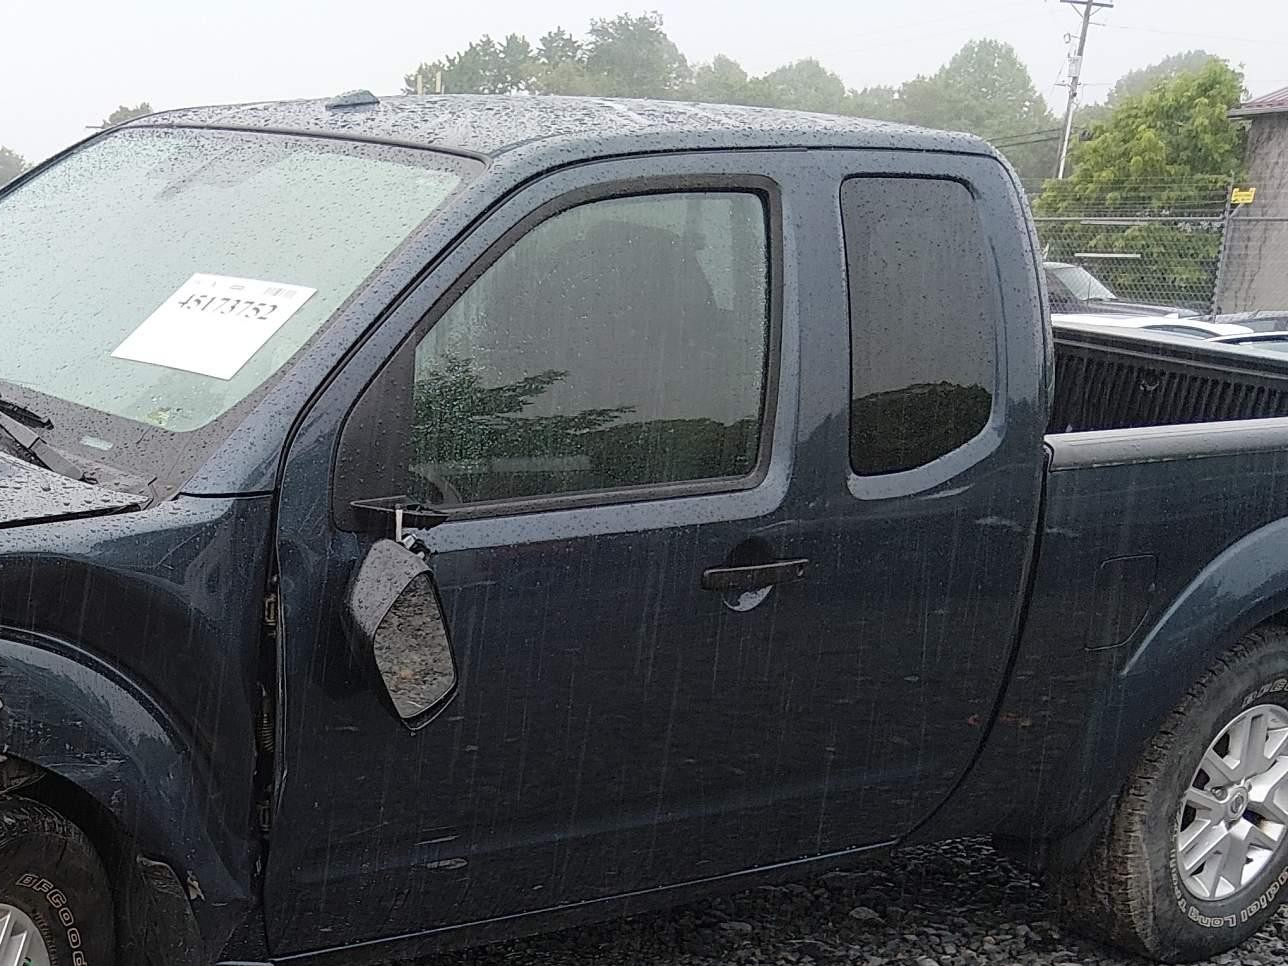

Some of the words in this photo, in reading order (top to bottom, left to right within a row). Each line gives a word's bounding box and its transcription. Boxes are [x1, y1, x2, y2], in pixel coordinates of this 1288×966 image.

[178, 293, 278, 320] 45173752
[1240, 865, 1288, 923] adial
[1187, 905, 1237, 928] Long
